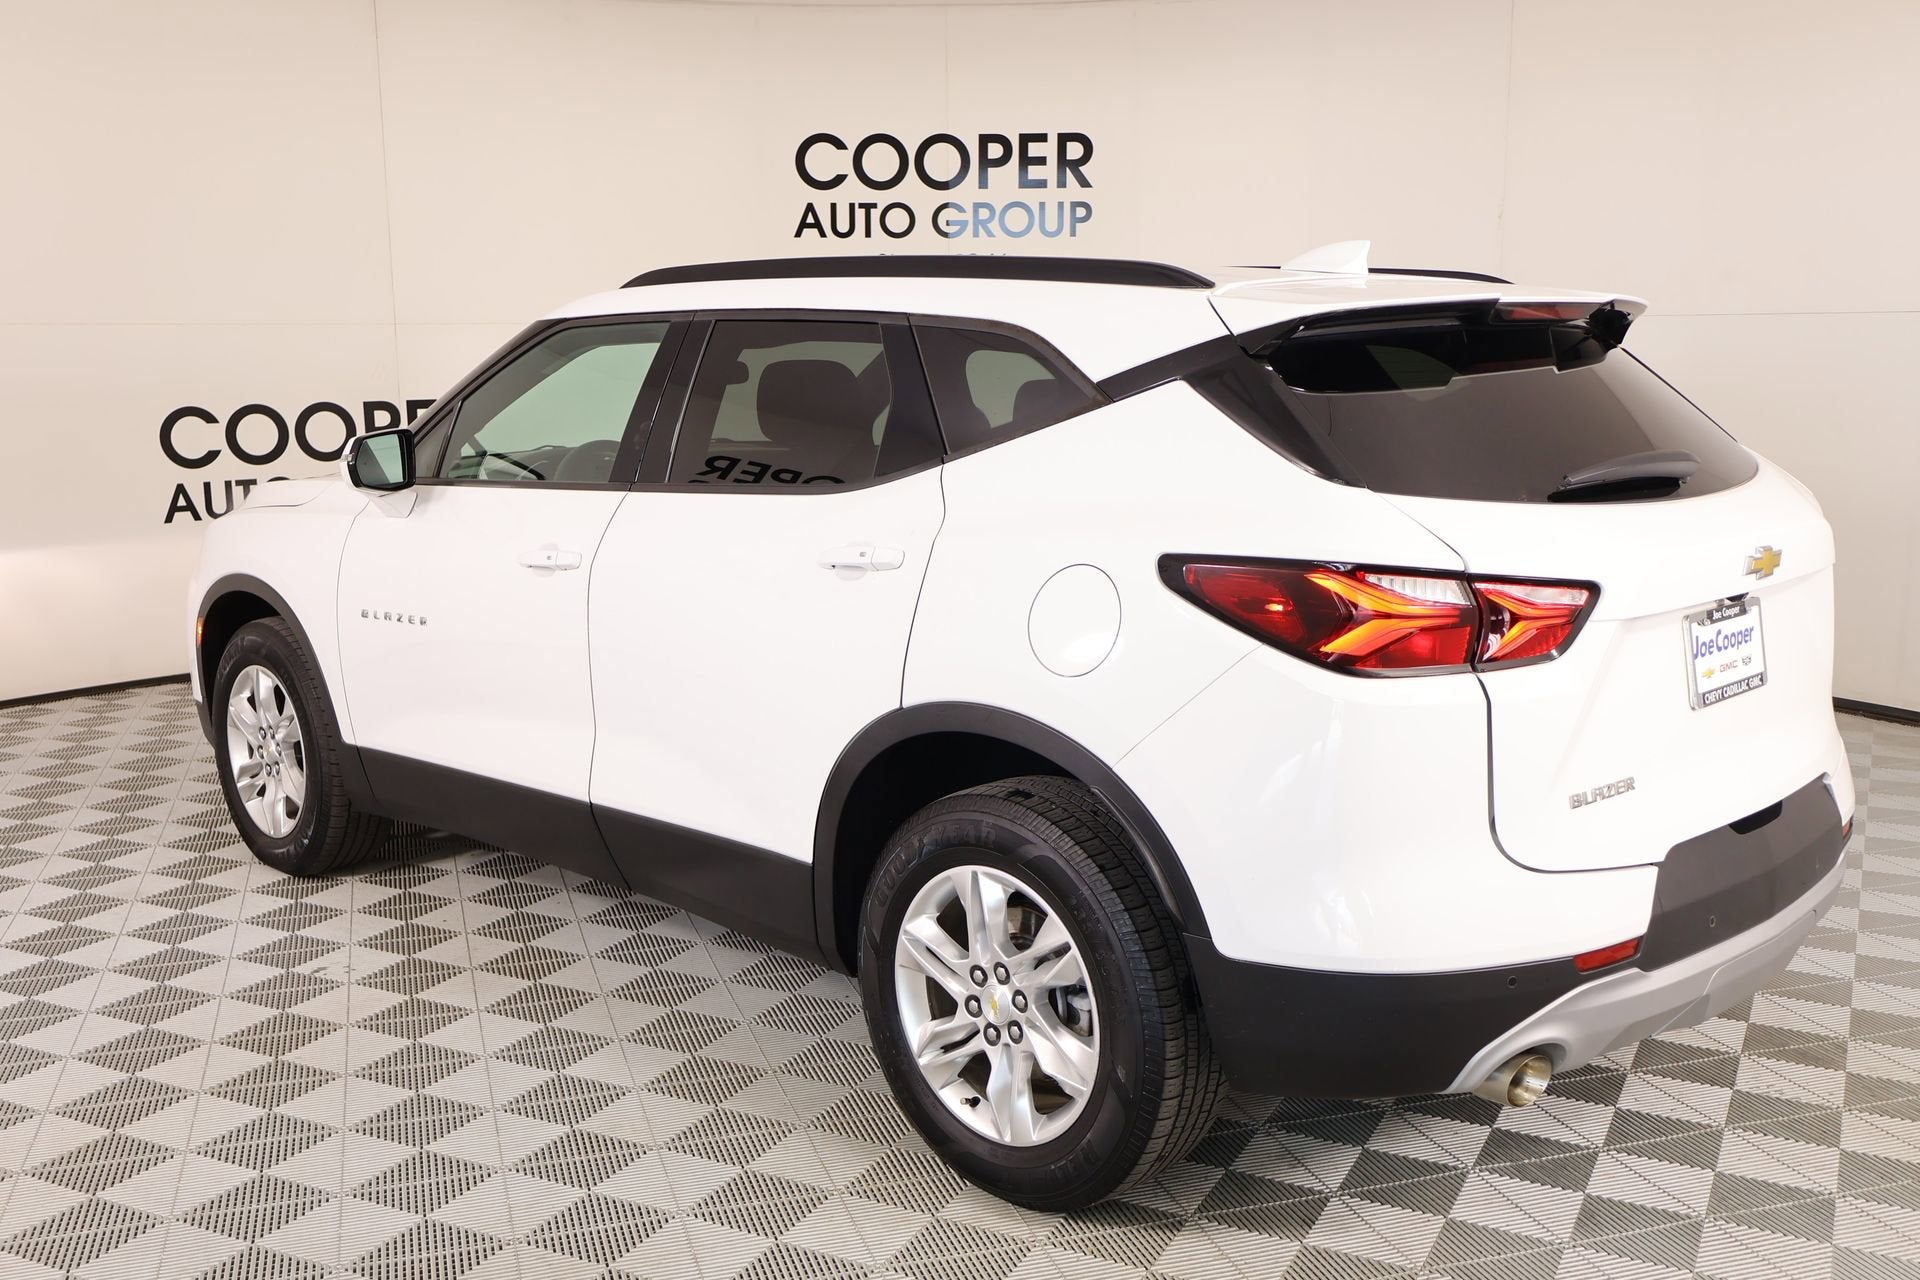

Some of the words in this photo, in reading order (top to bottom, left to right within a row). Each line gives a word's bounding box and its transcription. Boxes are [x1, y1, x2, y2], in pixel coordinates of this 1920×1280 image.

[795, 132, 1094, 191] COOPER
[793, 202, 916, 239] AUTO
[931, 201, 1093, 239] GROUP
[164, 476, 291, 524] AUT
[360, 608, 428, 627] BLAZER
[1712, 609, 1722, 620] Joe
[1722, 606, 1740, 618] Cooper
[1720, 660, 1738, 672] GMC
[1704, 688, 1723, 704] CHEVY
[1722, 679, 1750, 698] CADILLAC
[1748, 674, 1762, 688] GMC
[1568, 776, 1636, 810] BLAZER
